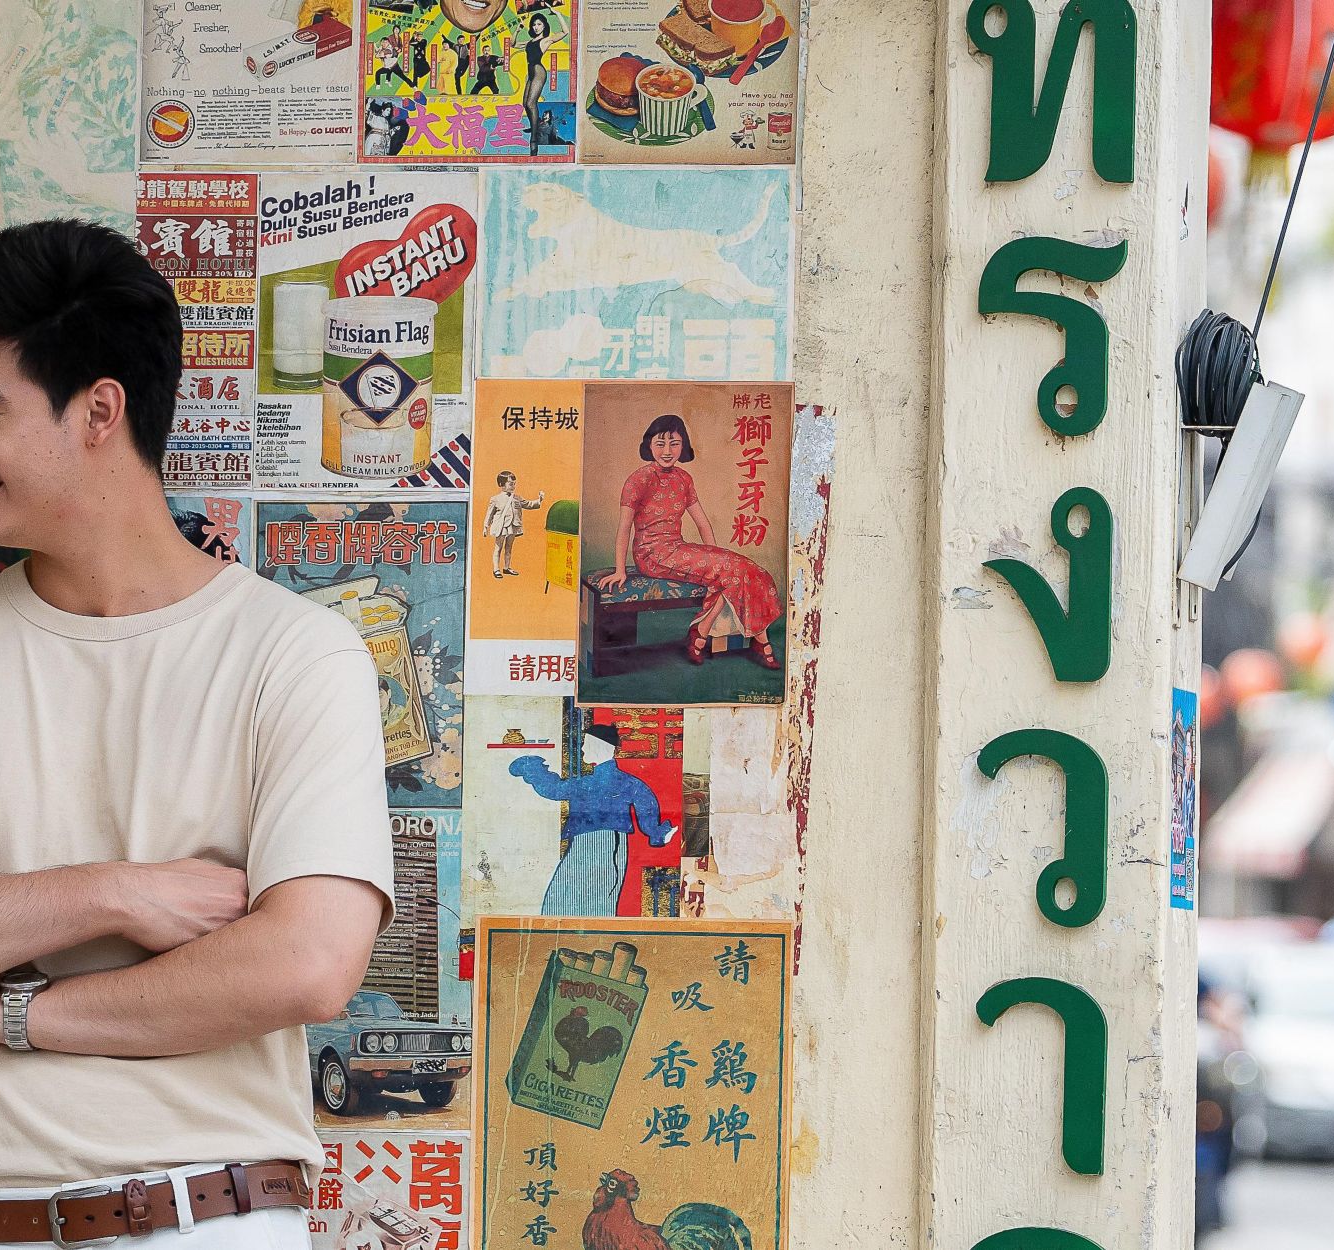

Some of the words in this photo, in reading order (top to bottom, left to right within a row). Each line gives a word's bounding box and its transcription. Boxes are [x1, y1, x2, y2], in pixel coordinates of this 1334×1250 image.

[185, 2, 222, 12] Cleaner,
[193, 23, 230, 34] Fresher,
[199, 44, 242, 54] Smoother!
[291, 84, 321, 94] better
[324, 126, 353, 134] LUCKY!
[403, 103, 530, 149] 大福星
[260, 184, 362, 218] Cobalah
[261, 215, 298, 234] Dulu
[302, 207, 342, 227] Susu
[345, 191, 415, 218] Bendera
[260, 230, 292, 248] Kini
[296, 221, 336, 239] Susu
[340, 206, 410, 233] Bendera
[197, 258, 255, 270] HOTEL
[344, 215, 456, 298] INSTANT
[392, 240, 467, 298] BARU
[177, 279, 226, 304] 雙龍
[328, 318, 392, 344] Frisian
[394, 320, 430, 345] Flag
[195, 357, 249, 366] GUESTHOUSE
[328, 342, 341, 353] Susu
[341, 345, 372, 355] Bendera
[256, 431, 289, 439] barunya
[341, 464, 372, 476] CREAM
[373, 464, 396, 476] MILK
[397, 459, 427, 474] POWDER
[353, 453, 402, 464] INSTANT
[730, 415, 772, 547] 獅子牙粉
[713, 940, 758, 985] 請
[557, 979, 641, 1026] ROOSTER
[671, 981, 715, 1012] 吸
[523, 1071, 606, 1109] CIGARETTES
